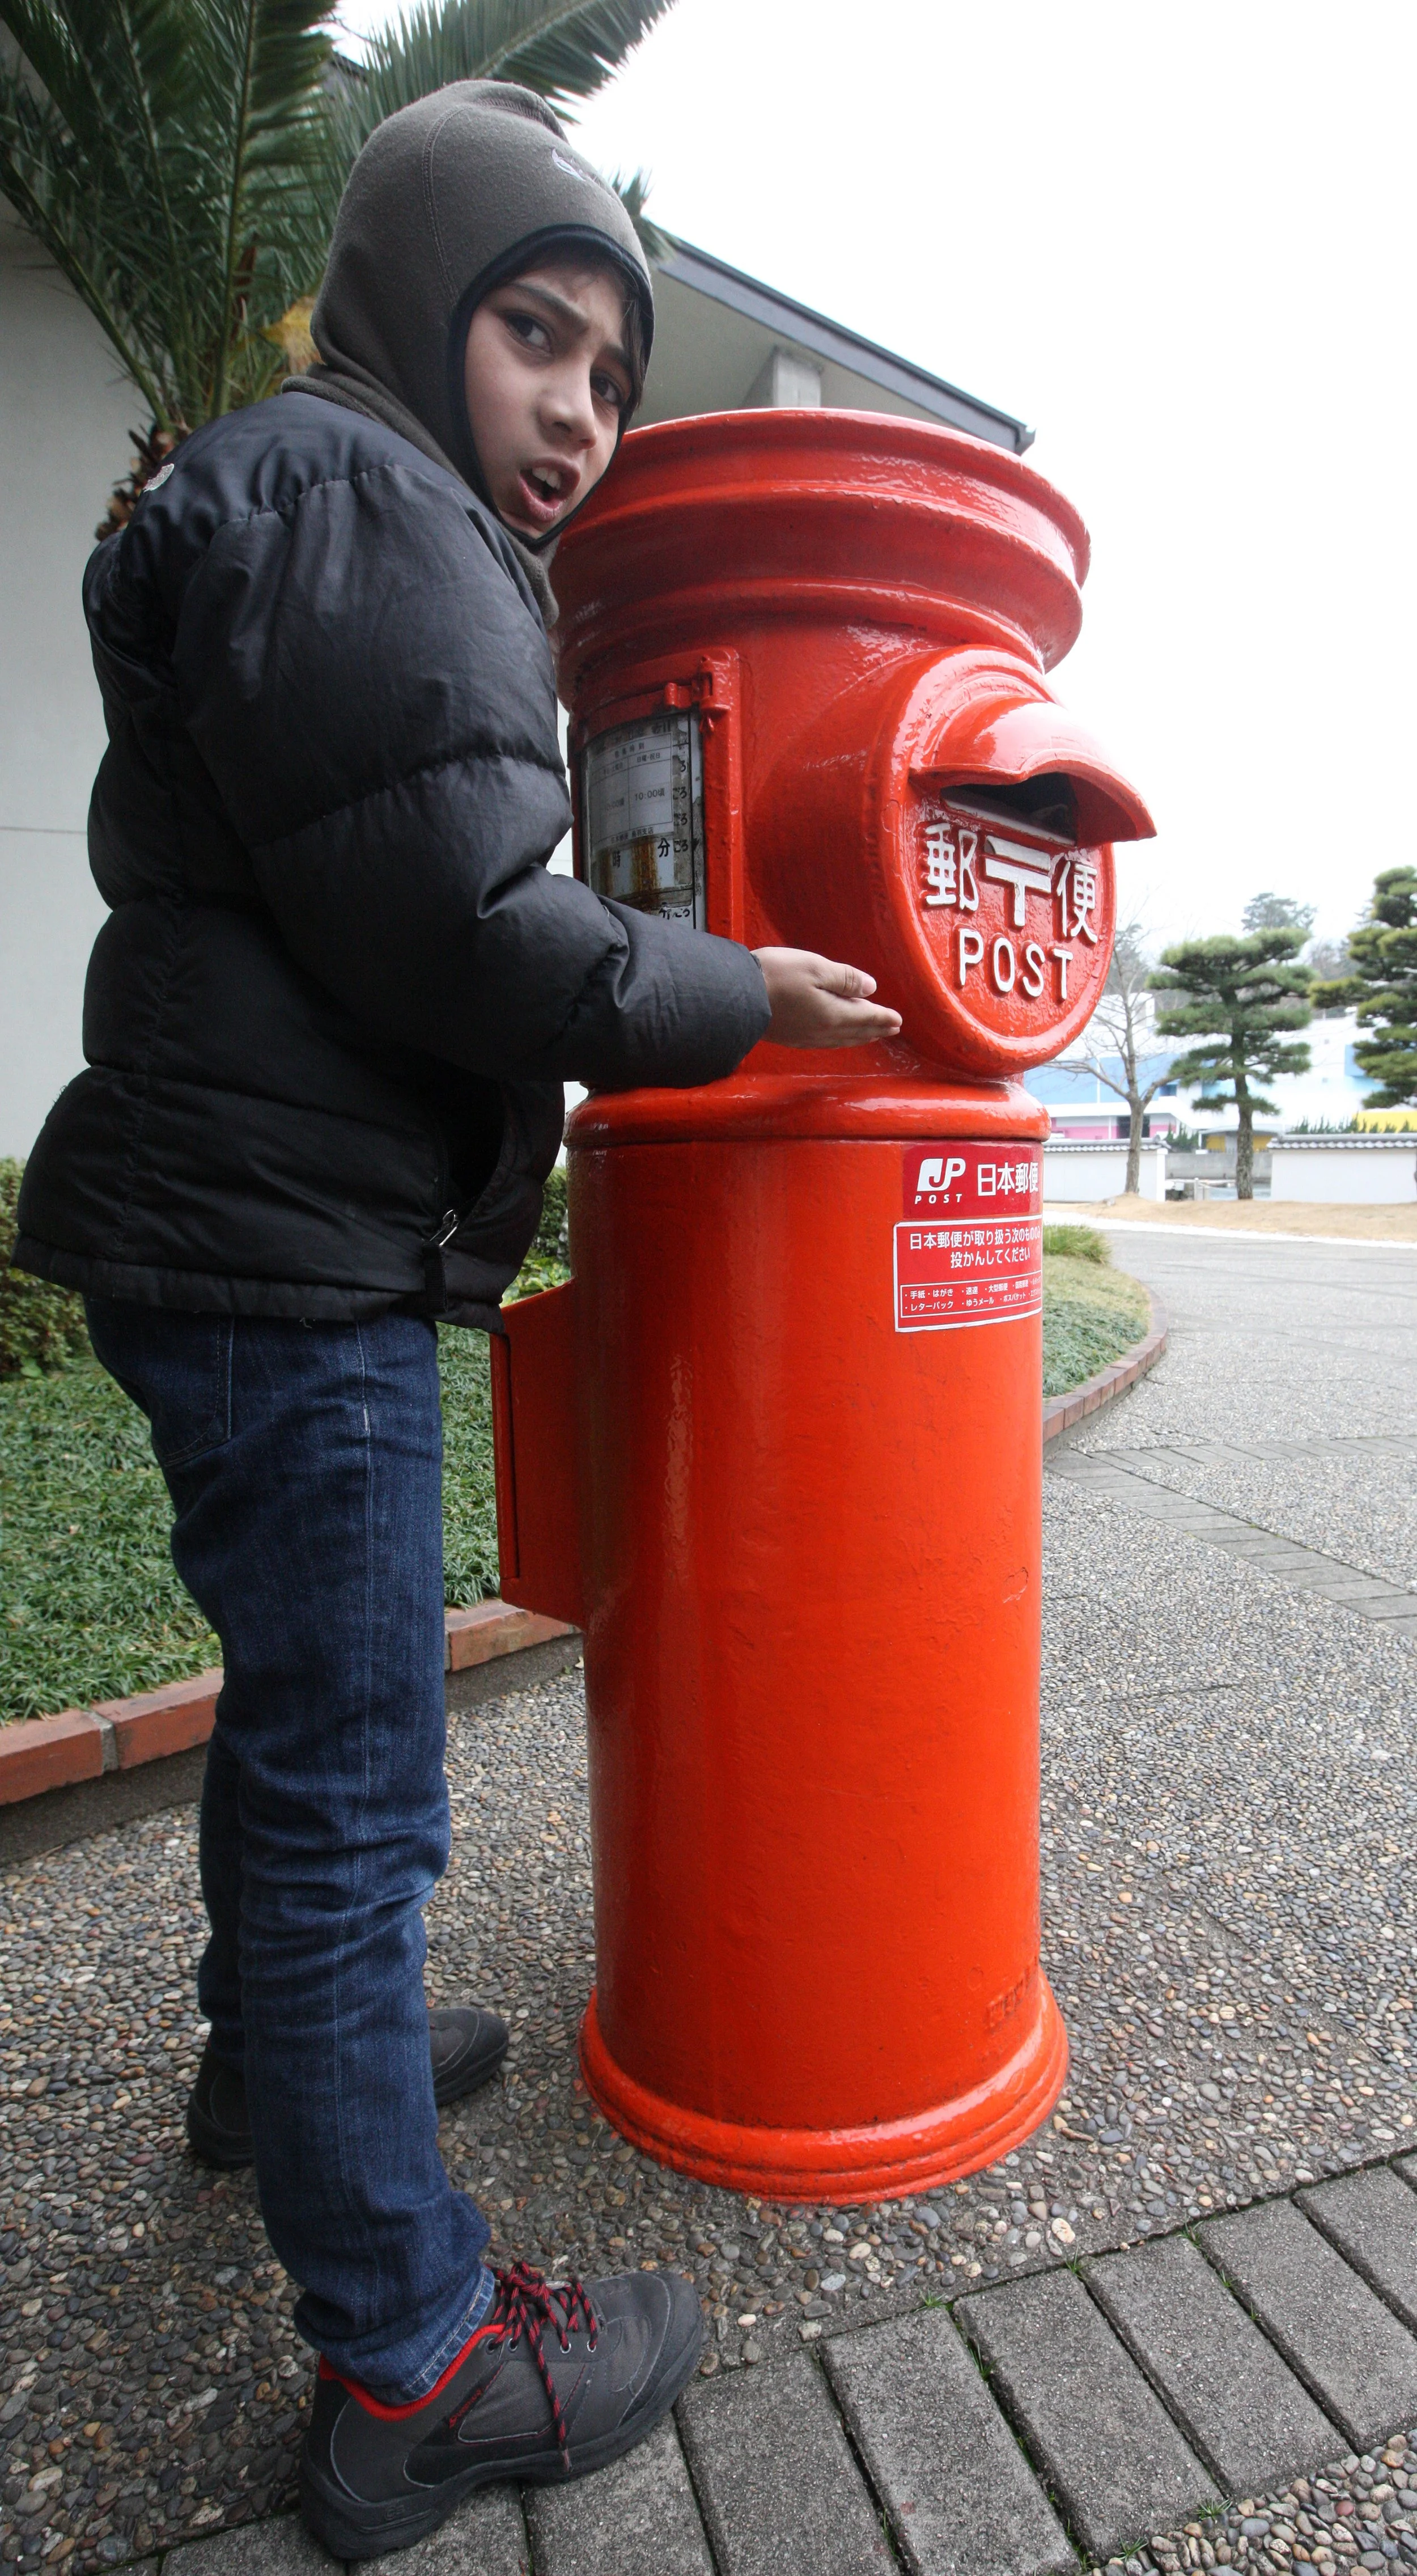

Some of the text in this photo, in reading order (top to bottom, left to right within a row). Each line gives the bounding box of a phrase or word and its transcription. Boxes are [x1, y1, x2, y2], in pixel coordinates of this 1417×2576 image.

[634, 788, 665, 800] 10:00頃
[613, 851, 621, 868] 時
[657, 838, 670, 858] 分
[959, 928, 1073, 1001] POST
[978, 1162, 1038, 1197] 日本郵便
[914, 1193, 962, 1205] POST
[910, 1227, 1041, 1250] 日本郵便が取り扱う次のもののみ
[951, 1247, 1030, 1269] 投かんしてください
[966, 1297, 994, 1307] ゆうメール
